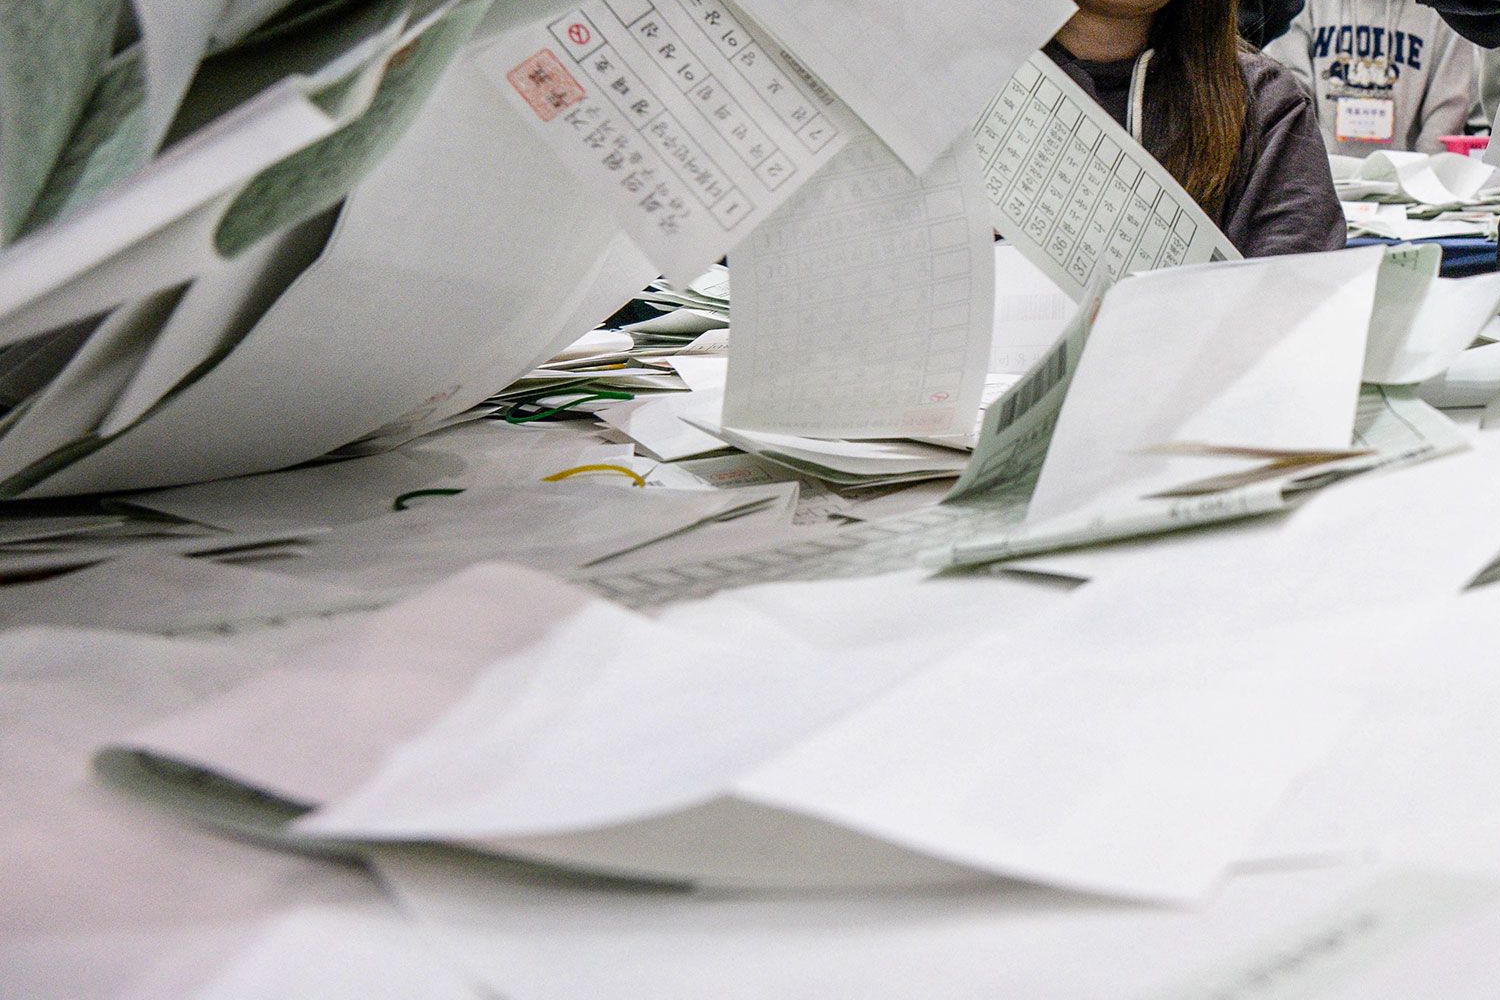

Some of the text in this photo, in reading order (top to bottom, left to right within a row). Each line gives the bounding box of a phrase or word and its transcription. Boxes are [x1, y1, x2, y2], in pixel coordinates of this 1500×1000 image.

[1314, 25, 1424, 70] WOODIE
[639, 20, 784, 179] 2 국민의힘 이성심
[739, 50, 808, 122] 진보당
[595, 56, 740, 217] 1 더불어민주당 정태호
[805, 125, 824, 143] 7
[983, 100, 1051, 197] 33 자유민주당
[1006, 195, 1026, 218] 34
[1027, 214, 1048, 237] 35
[1071, 178, 1128, 278] 37 한나라당
[1046, 234, 1069, 258] 36
